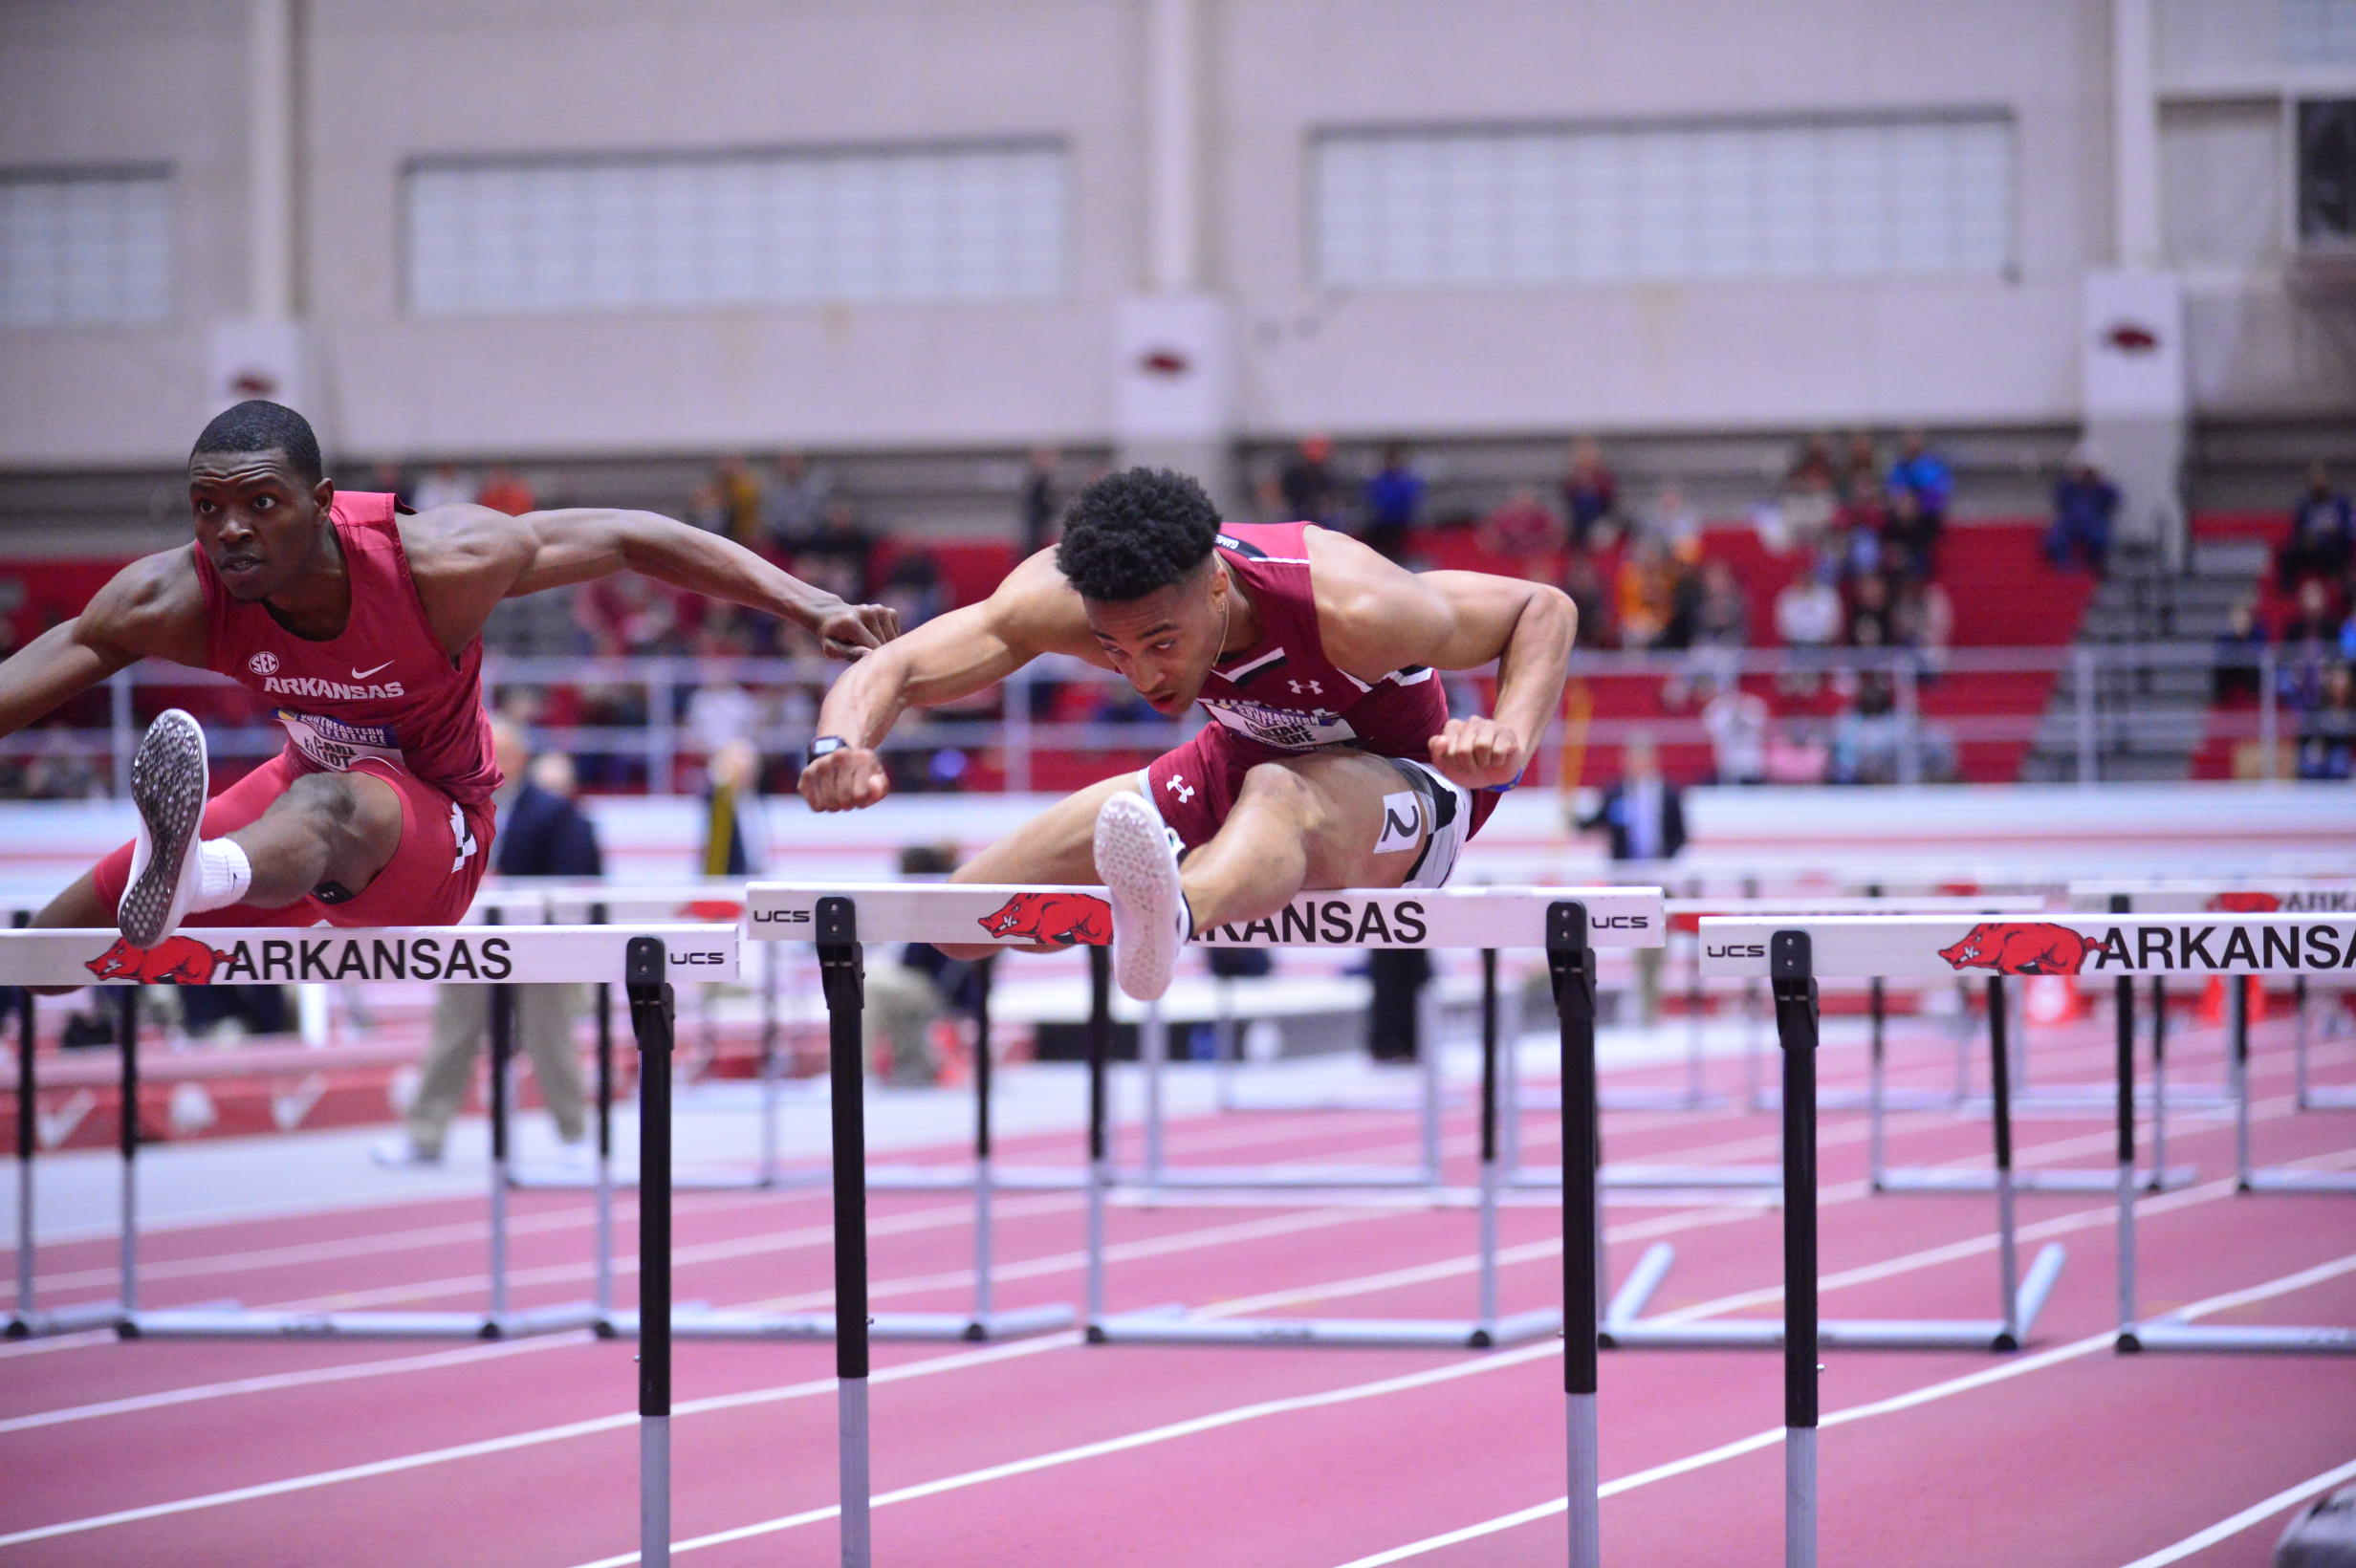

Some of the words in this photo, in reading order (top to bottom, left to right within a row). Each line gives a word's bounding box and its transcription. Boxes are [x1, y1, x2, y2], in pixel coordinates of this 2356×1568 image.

[251, 652, 276, 673] SEC
[264, 677, 404, 700] ARKANSAS
[1381, 805, 1419, 842] 2
[753, 909, 810, 924] UCS
[1592, 914, 1647, 929] UCS
[223, 938, 513, 981] ARKANSAS
[670, 951, 726, 966] UCS
[1707, 945, 1765, 959] UCS
